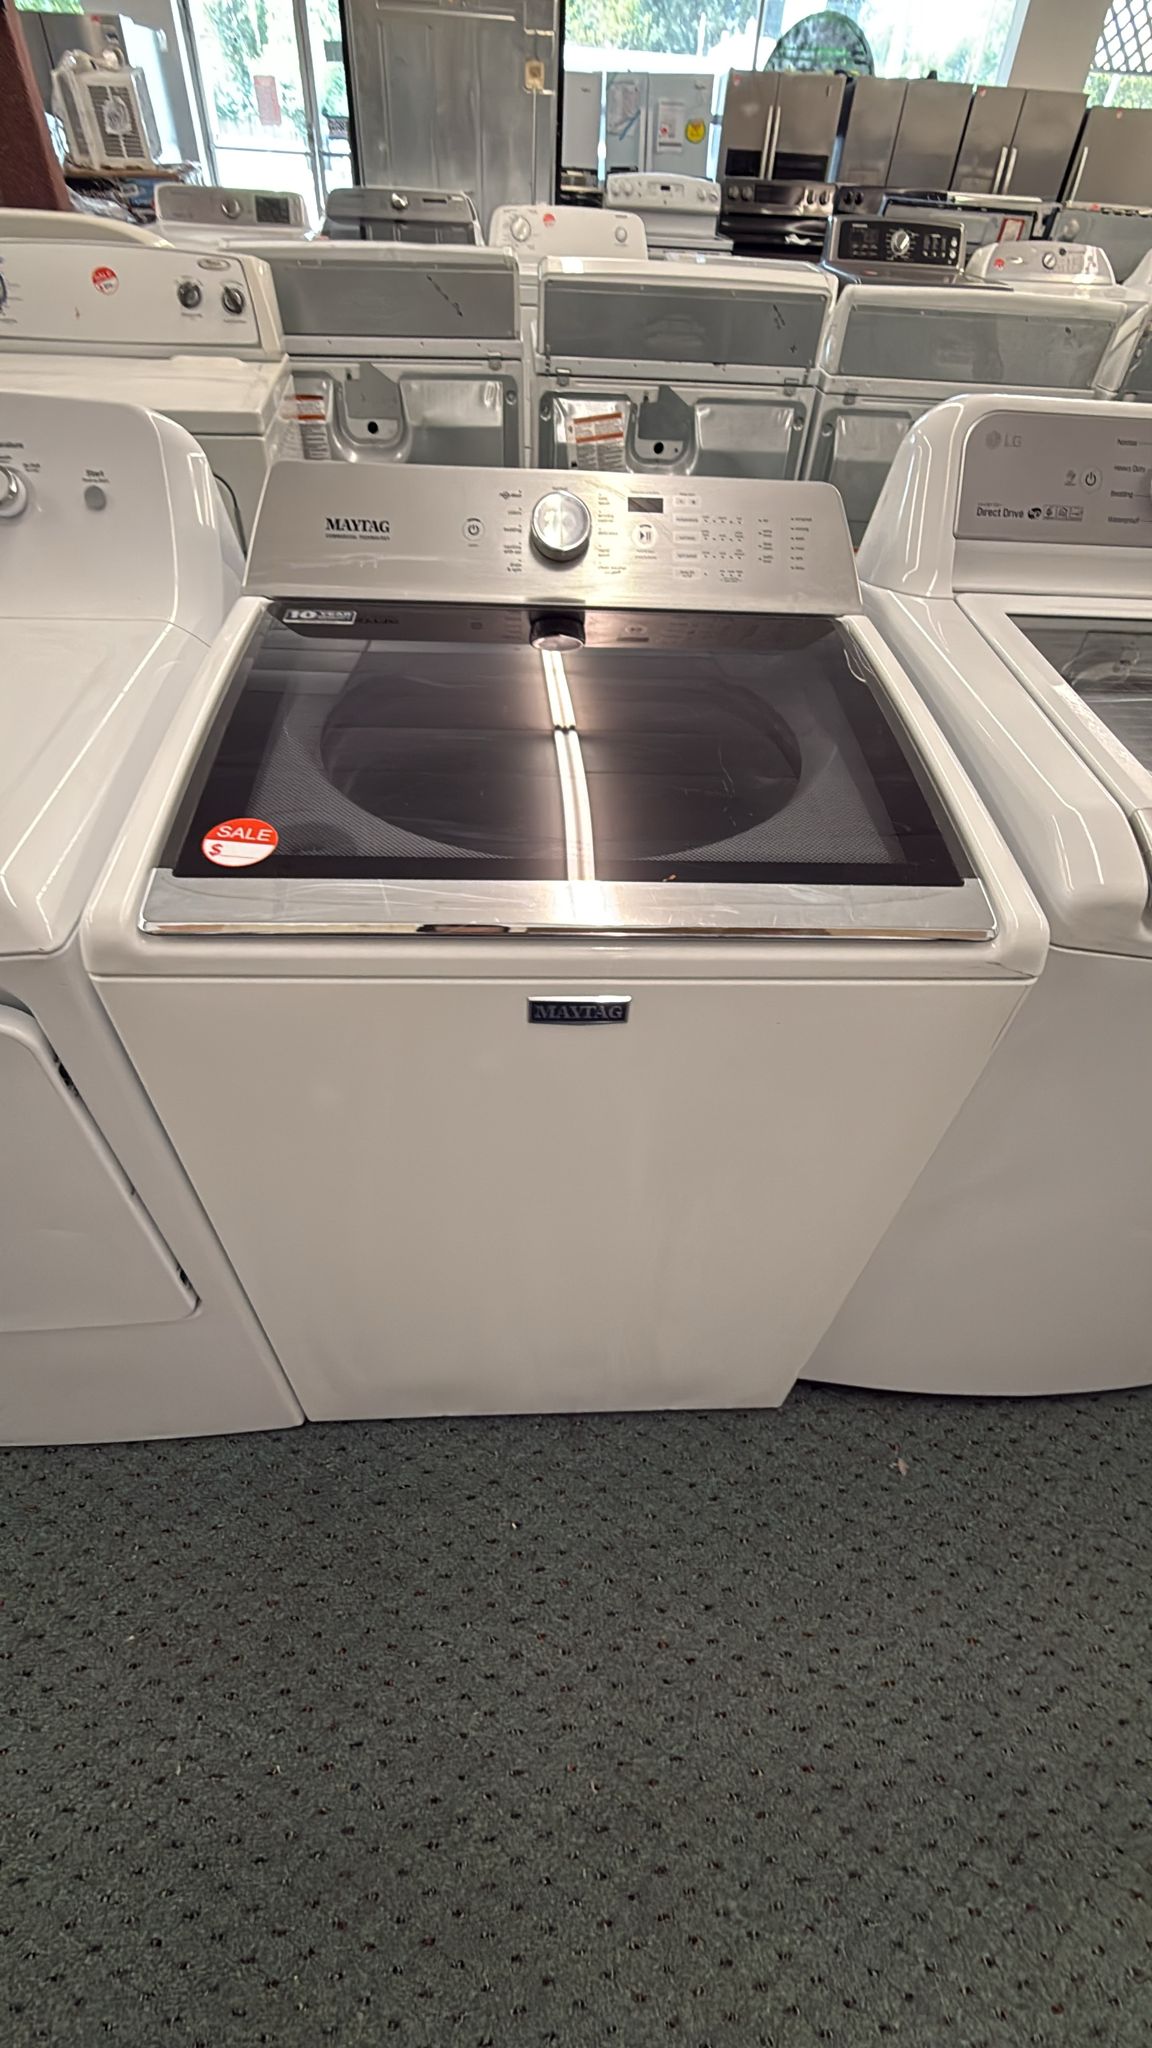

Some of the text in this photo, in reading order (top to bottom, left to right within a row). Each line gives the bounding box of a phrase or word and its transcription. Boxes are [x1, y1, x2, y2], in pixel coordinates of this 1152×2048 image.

[1004, 435, 1023, 448] LG
[976, 507, 1024, 518] Direct Drive
[325, 517, 390, 533] MAYTAG
[216, 825, 273, 842] SALE
[533, 1004, 624, 1019] MAYTAG
